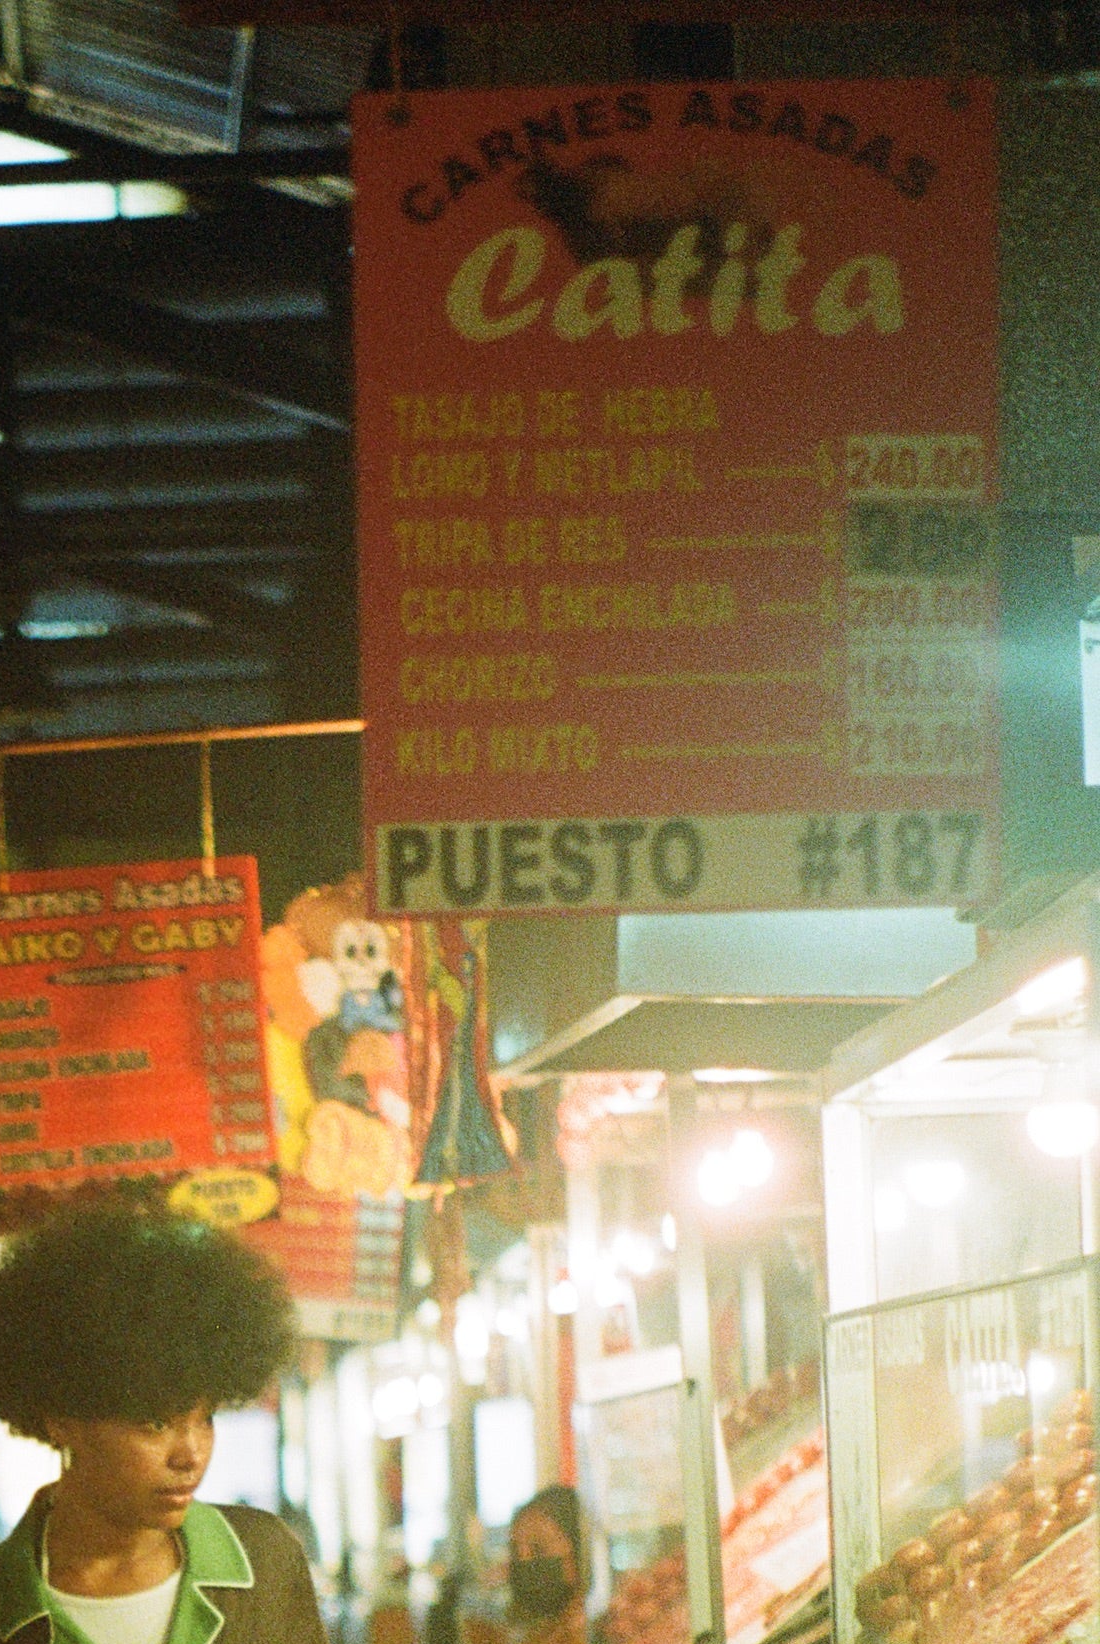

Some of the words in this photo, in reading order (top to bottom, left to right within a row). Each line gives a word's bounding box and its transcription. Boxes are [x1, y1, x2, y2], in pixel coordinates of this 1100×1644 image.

[402, 92, 653, 225] CARNES
[679, 91, 938, 199] ASADAS
[446, 222, 904, 343] Catita
[390, 392, 524, 441] TASAJO
[535, 389, 583, 438] DE
[603, 386, 721, 434] HEBRA
[391, 450, 490, 498] LOMO
[501, 449, 523, 496] Y
[393, 519, 493, 567] TRIPA
[503, 518, 550, 565] DE
[559, 515, 628, 563] RES
[399, 585, 528, 634] CECINA
[539, 582, 737, 631] ENCHILADA
[399, 655, 557, 703] CHORIZO
[395, 726, 478, 774] KILO
[488, 723, 600, 772] MIXTO
[387, 820, 702, 909] PUESTO
[801, 813, 984, 899] #187
[112, 874, 245, 910] Asadas
[95, 927, 121, 955] Y
[131, 917, 245, 953] GABY
